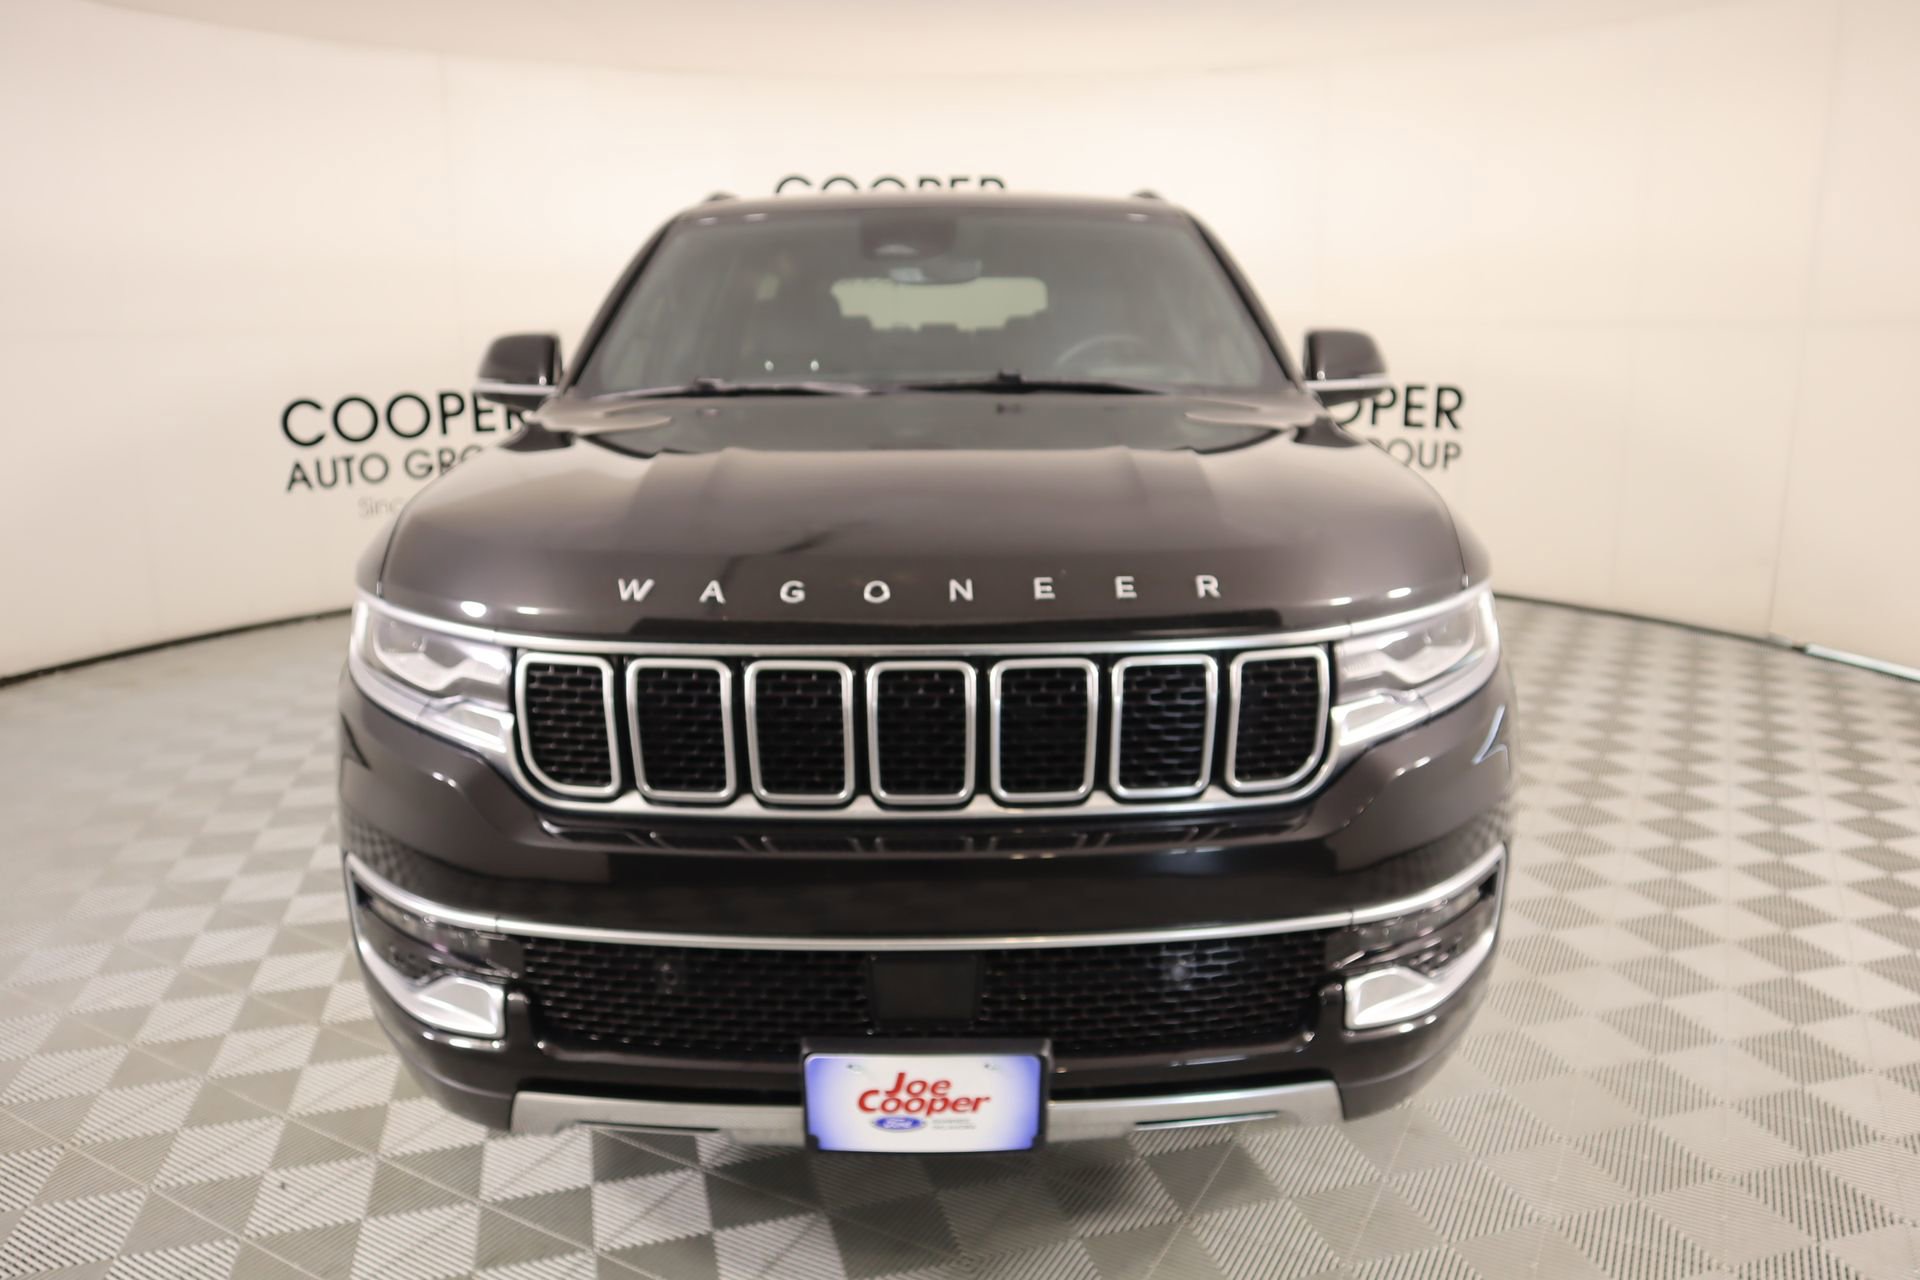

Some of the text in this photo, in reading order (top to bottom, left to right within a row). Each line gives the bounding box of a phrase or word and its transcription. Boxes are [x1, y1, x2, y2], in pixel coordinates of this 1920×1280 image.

[1367, 437, 1462, 470] OUP
[286, 453, 390, 492] AUTO
[617, 574, 1221, 604] WAGONEER
[885, 1072, 952, 1098] Joe
[858, 1089, 990, 1116] Cooper
